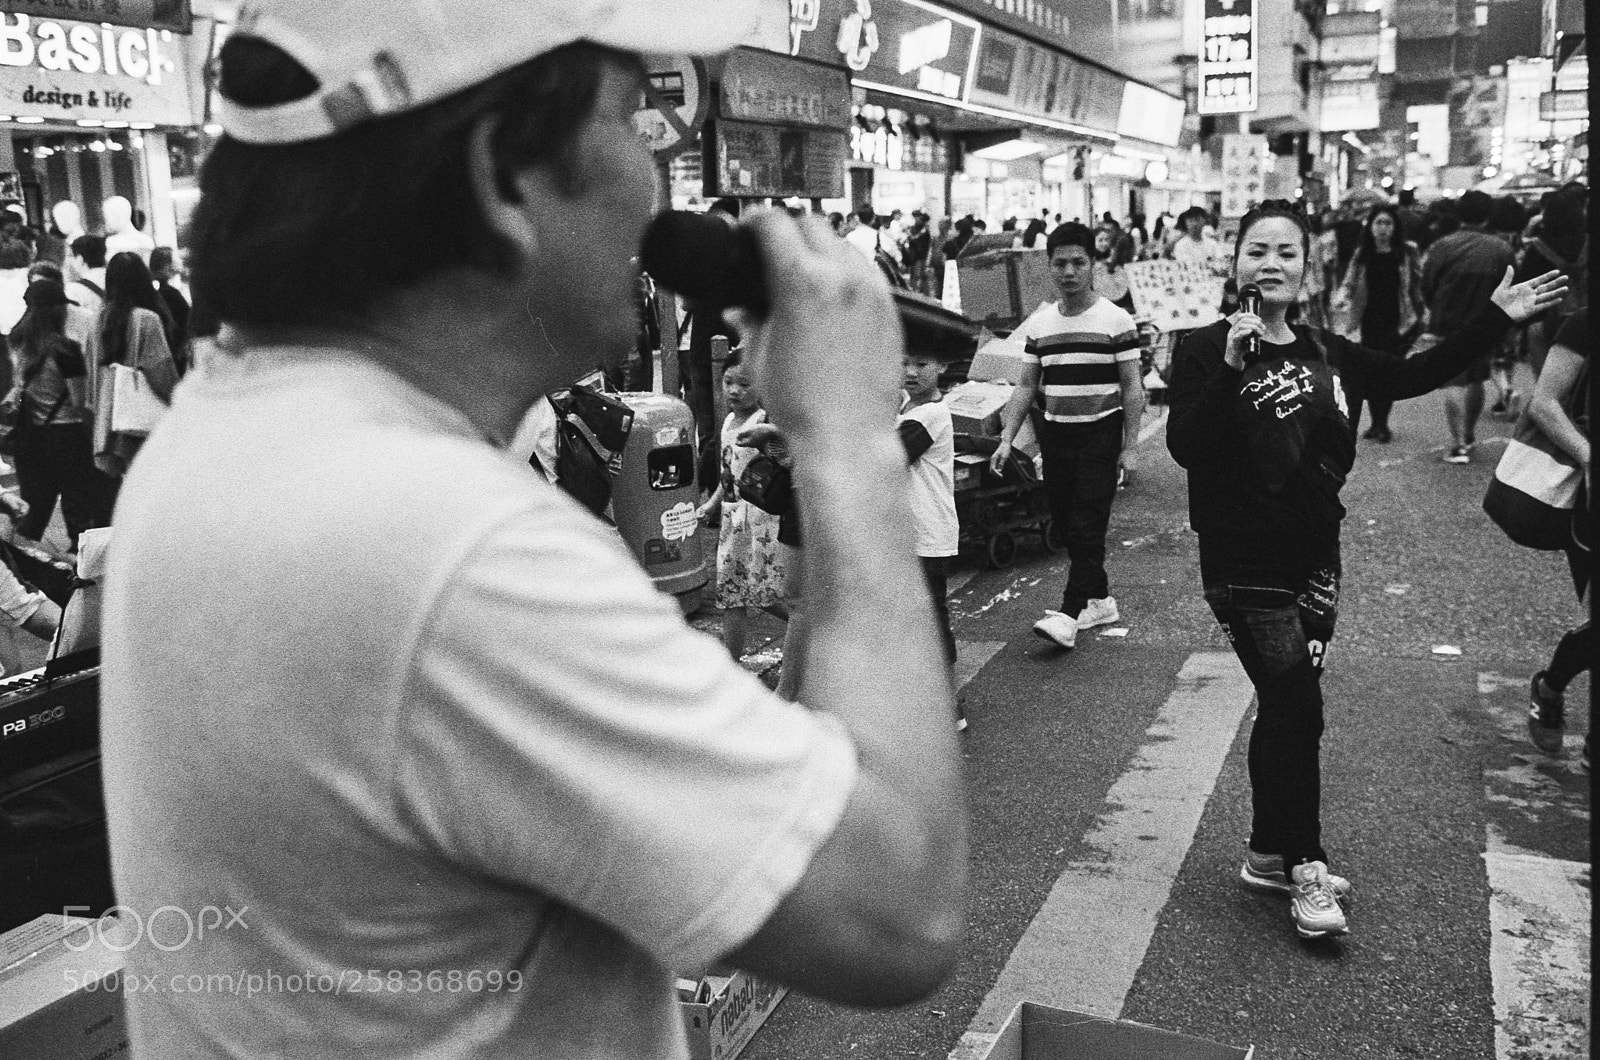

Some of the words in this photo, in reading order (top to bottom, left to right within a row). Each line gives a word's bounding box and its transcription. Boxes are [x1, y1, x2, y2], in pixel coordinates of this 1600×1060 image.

[23, 85, 83, 109] design
[88, 91, 99, 107] &
[104, 91, 132, 112] life
